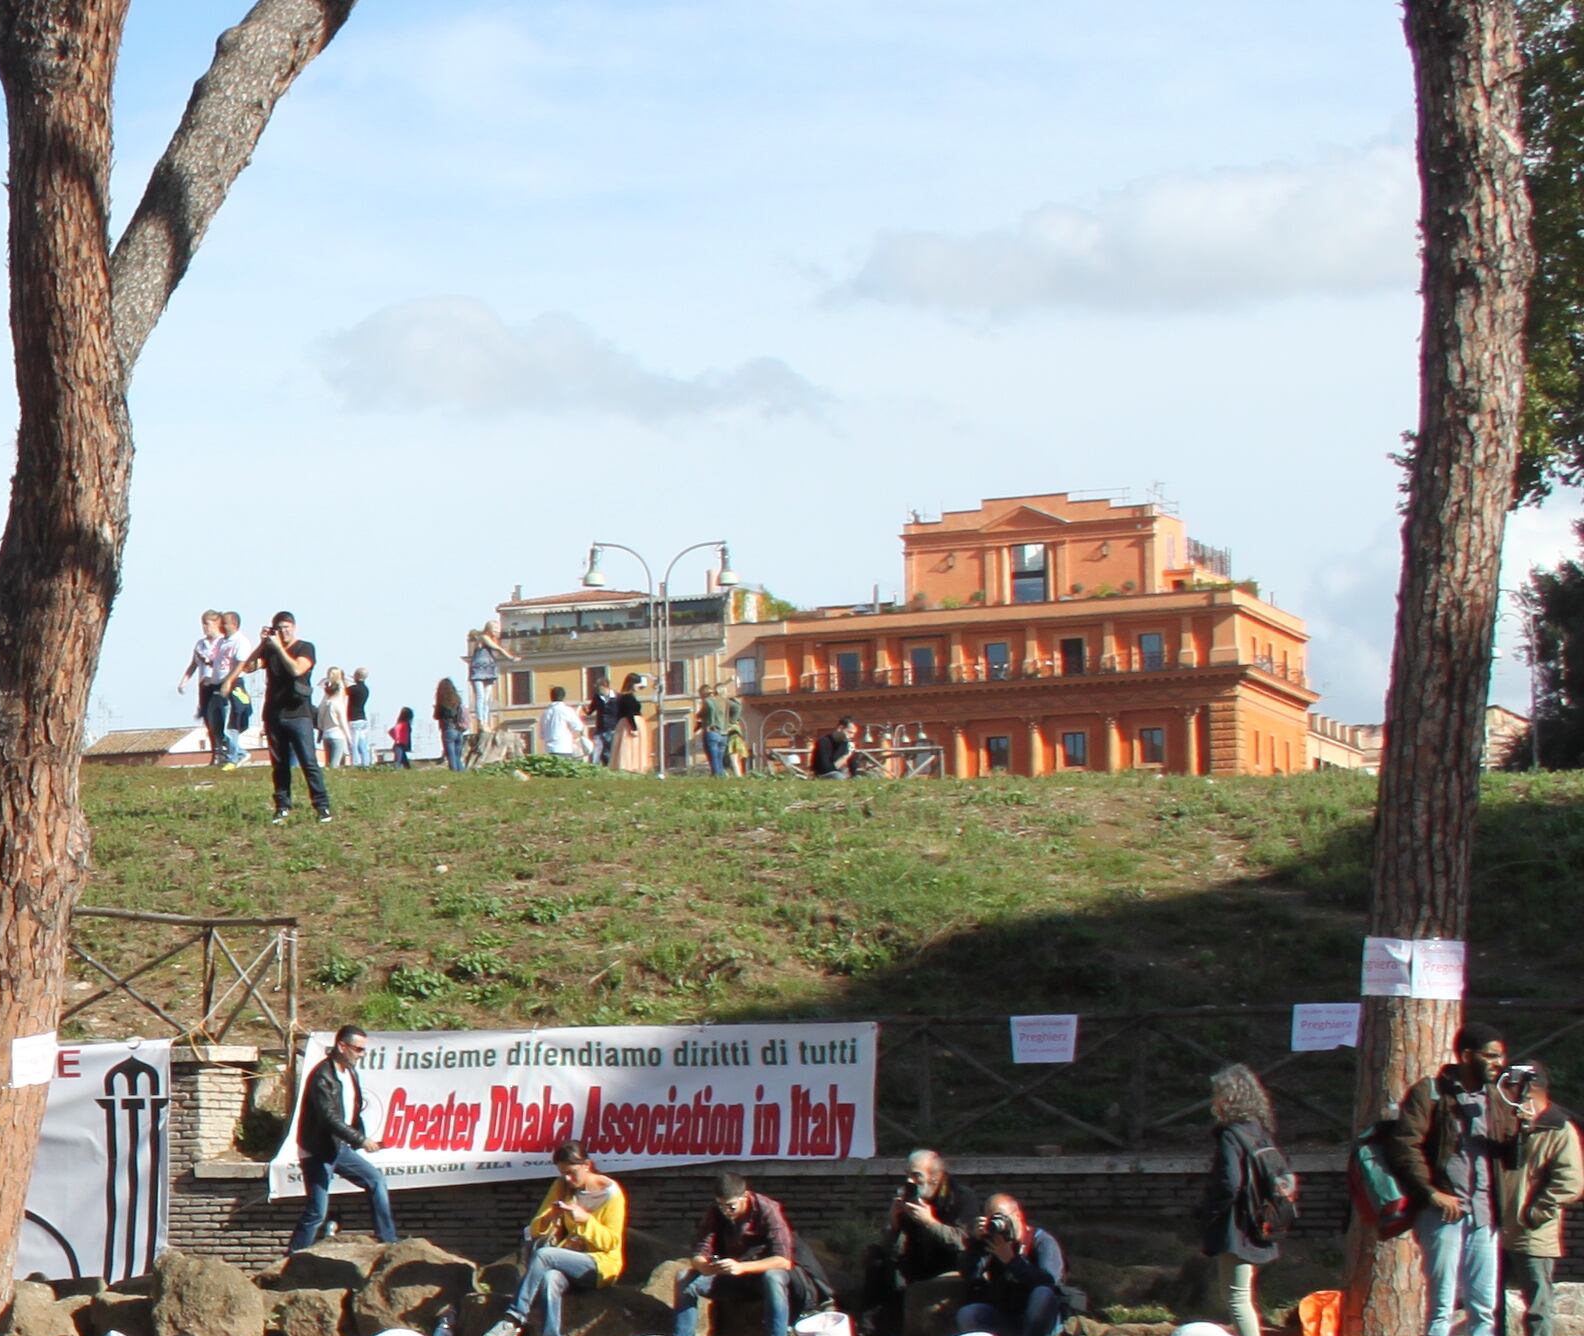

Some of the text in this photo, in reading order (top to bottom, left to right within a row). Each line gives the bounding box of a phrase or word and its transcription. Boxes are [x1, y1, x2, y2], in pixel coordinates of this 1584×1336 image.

[395, 1043, 497, 1070] insieme
[506, 1039, 662, 1067] difendiamo
[673, 1038, 750, 1067] diritti
[760, 1038, 788, 1066] di
[798, 1037, 857, 1065] tutti
[382, 1083, 856, 1161] Greater Dhaka Association in Italy
